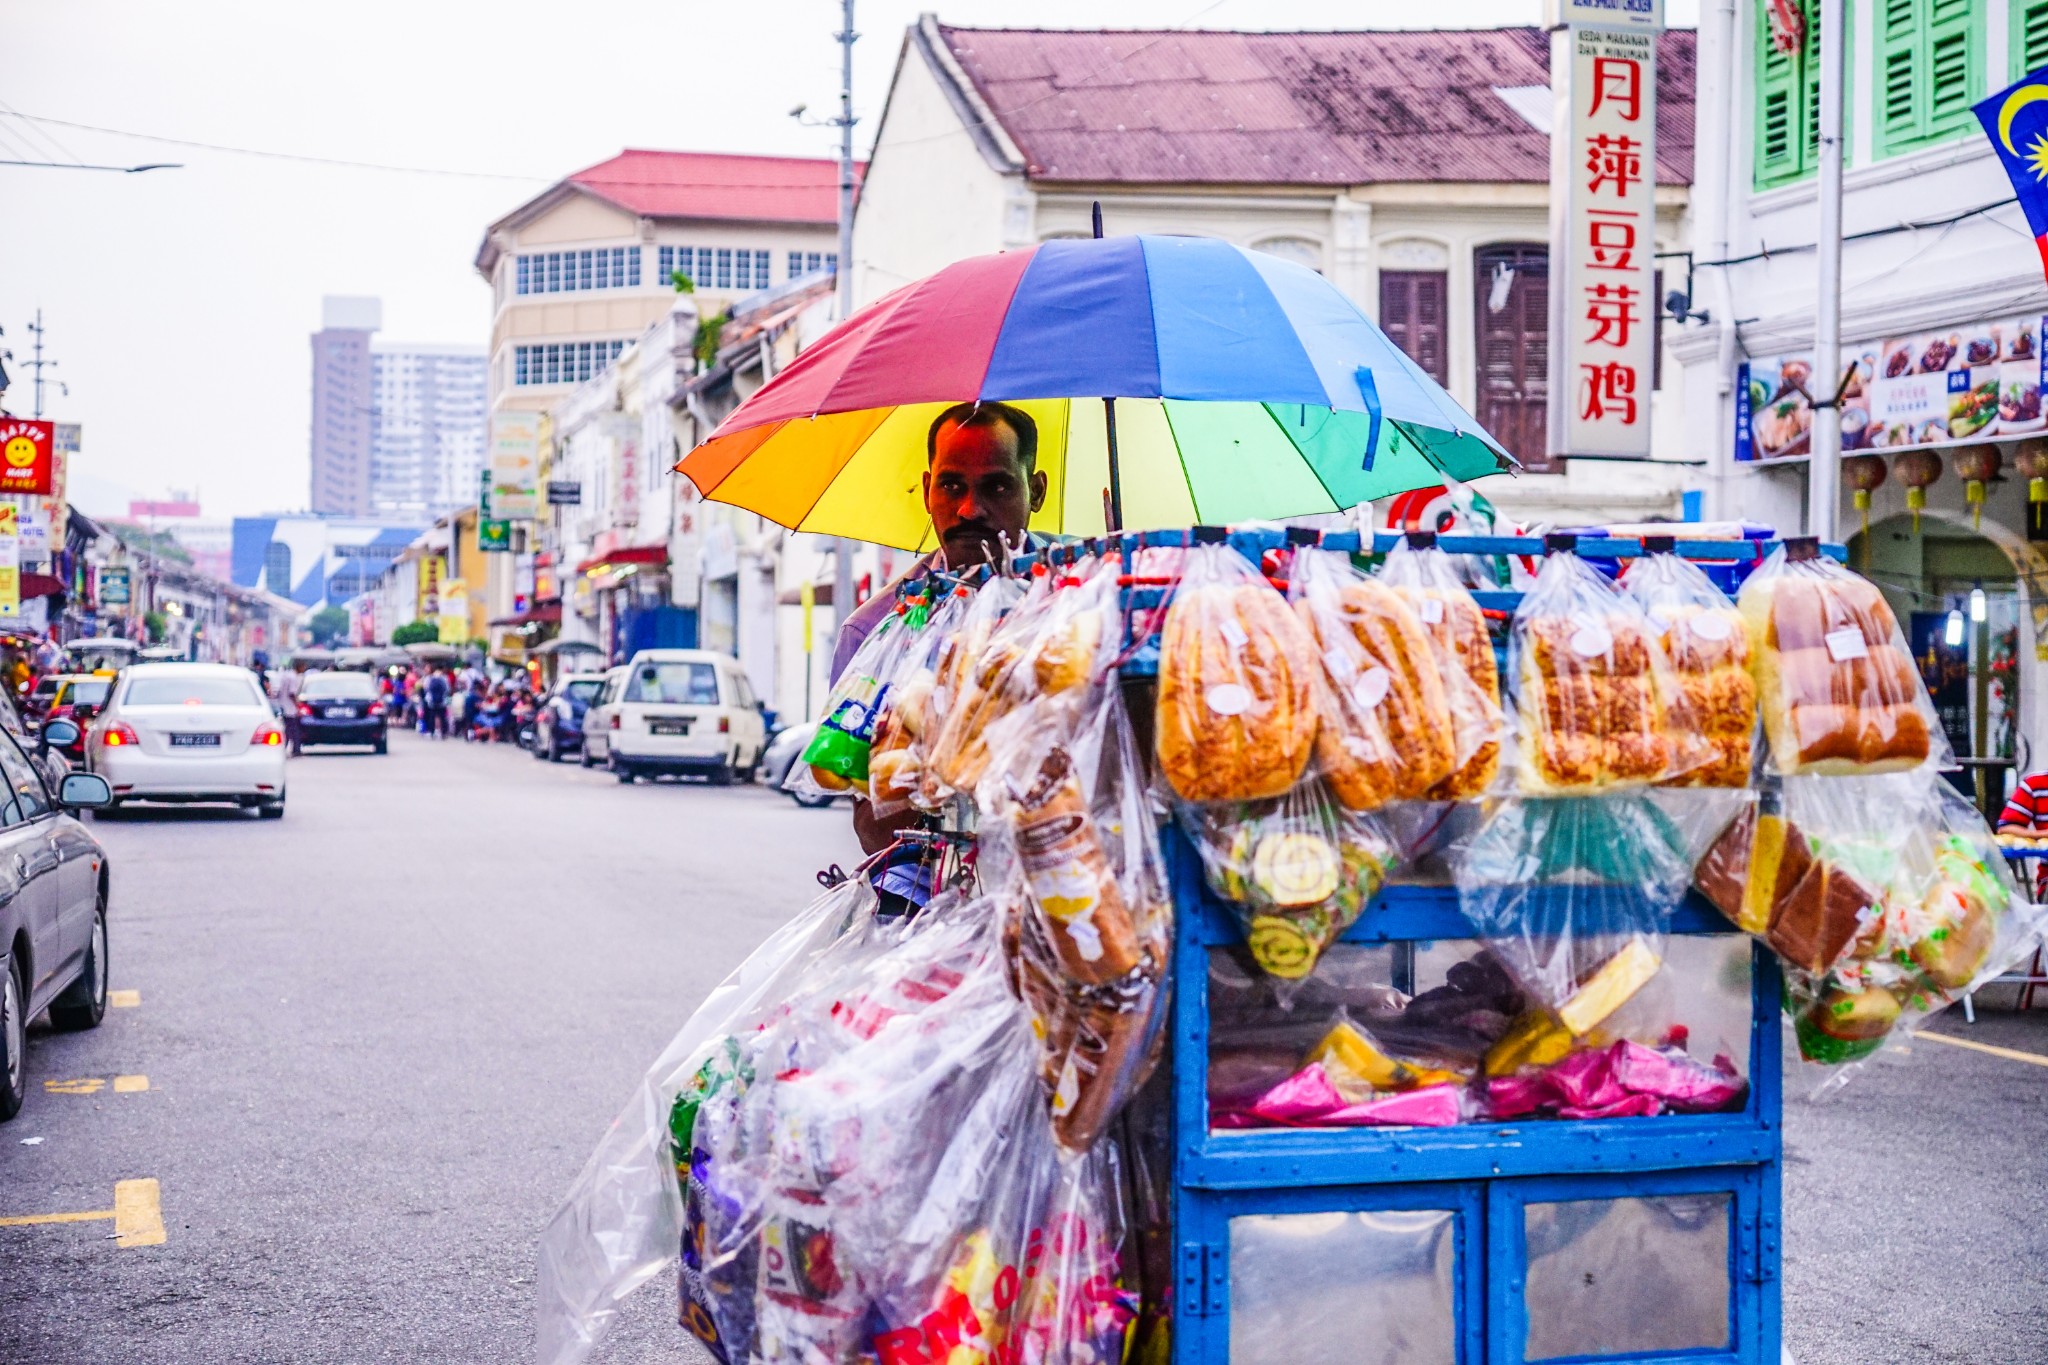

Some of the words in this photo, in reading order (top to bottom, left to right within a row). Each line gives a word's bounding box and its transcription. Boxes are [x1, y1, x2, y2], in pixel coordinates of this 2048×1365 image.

[1579, 31, 1602, 42] KEDA
[1606, 33, 1650, 46] MAKANAN
[1578, 44, 1597, 55] DAN
[1605, 47, 1650, 60] MINUMAN
[1579, 56, 1642, 426] 月萍豆芽鸡
[0, 422, 46, 444] HAPPY
[5, 467, 34, 478] MART
